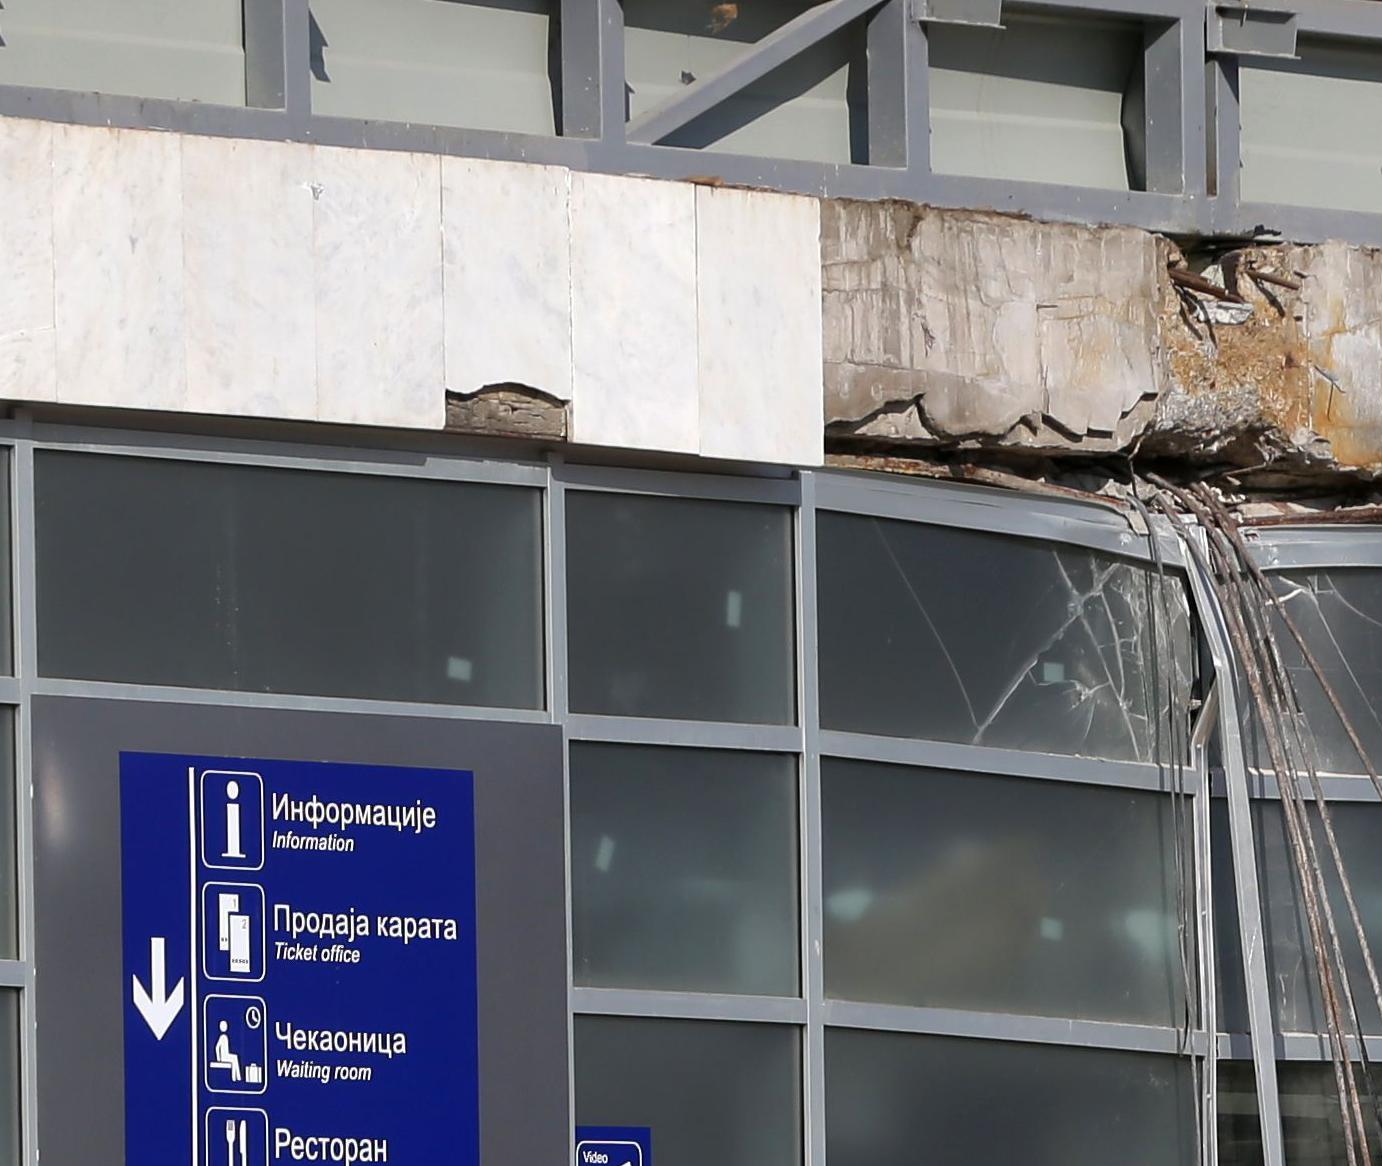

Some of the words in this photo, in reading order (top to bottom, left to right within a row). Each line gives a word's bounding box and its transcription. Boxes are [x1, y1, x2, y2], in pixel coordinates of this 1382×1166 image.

[272, 793, 436, 833] Информације
[272, 831, 354, 851] Information
[274, 904, 369, 942] Продаја
[377, 915, 457, 944] карата
[275, 942, 318, 962] Ticket
[321, 945, 360, 963] office
[275, 1022, 406, 1058] Чекаоница
[277, 1060, 330, 1083] Waiting
[334, 1065, 371, 1080] room
[583, 1151, 608, 1164] Video
